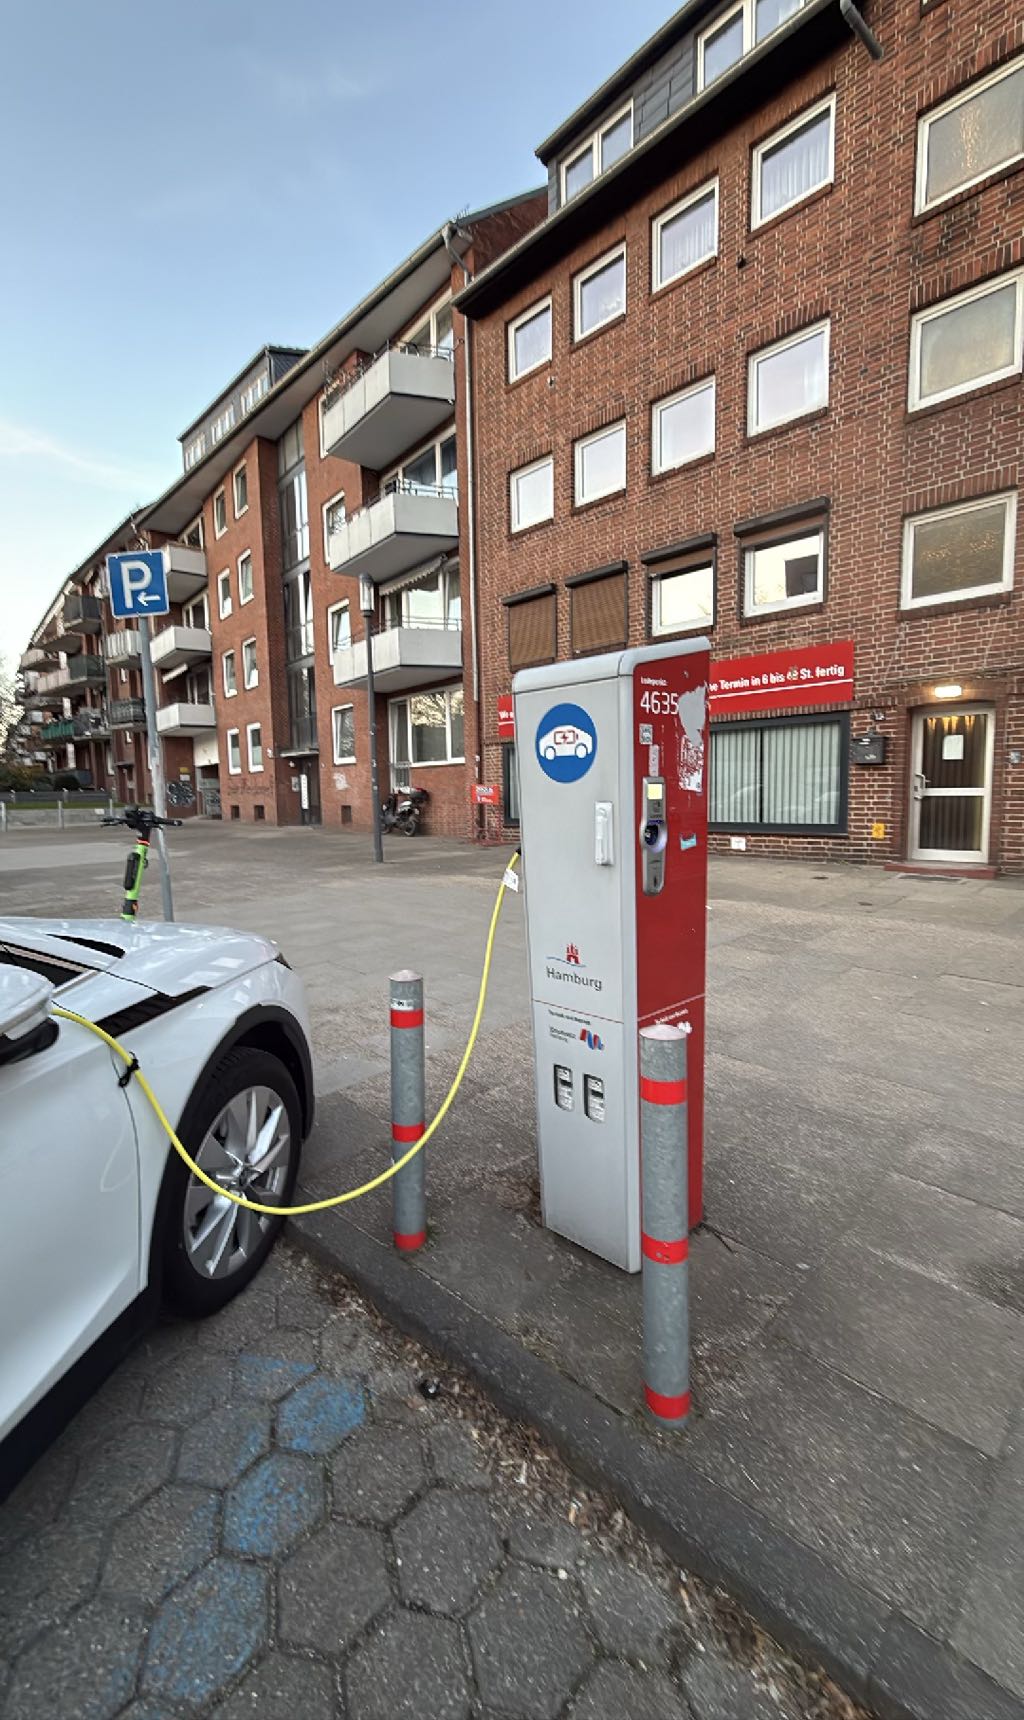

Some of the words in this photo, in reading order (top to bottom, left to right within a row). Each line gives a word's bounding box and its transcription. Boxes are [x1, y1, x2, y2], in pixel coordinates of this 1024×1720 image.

[121, 560, 152, 609] P
[719, 678, 749, 690] Termin
[751, 676, 761, 686] in
[769, 672, 785, 684] bis
[799, 668, 813, 680] St.
[815, 664, 845, 677] fertig
[640, 690, 679, 715] 4635
[546, 966, 602, 991] Hamburg
